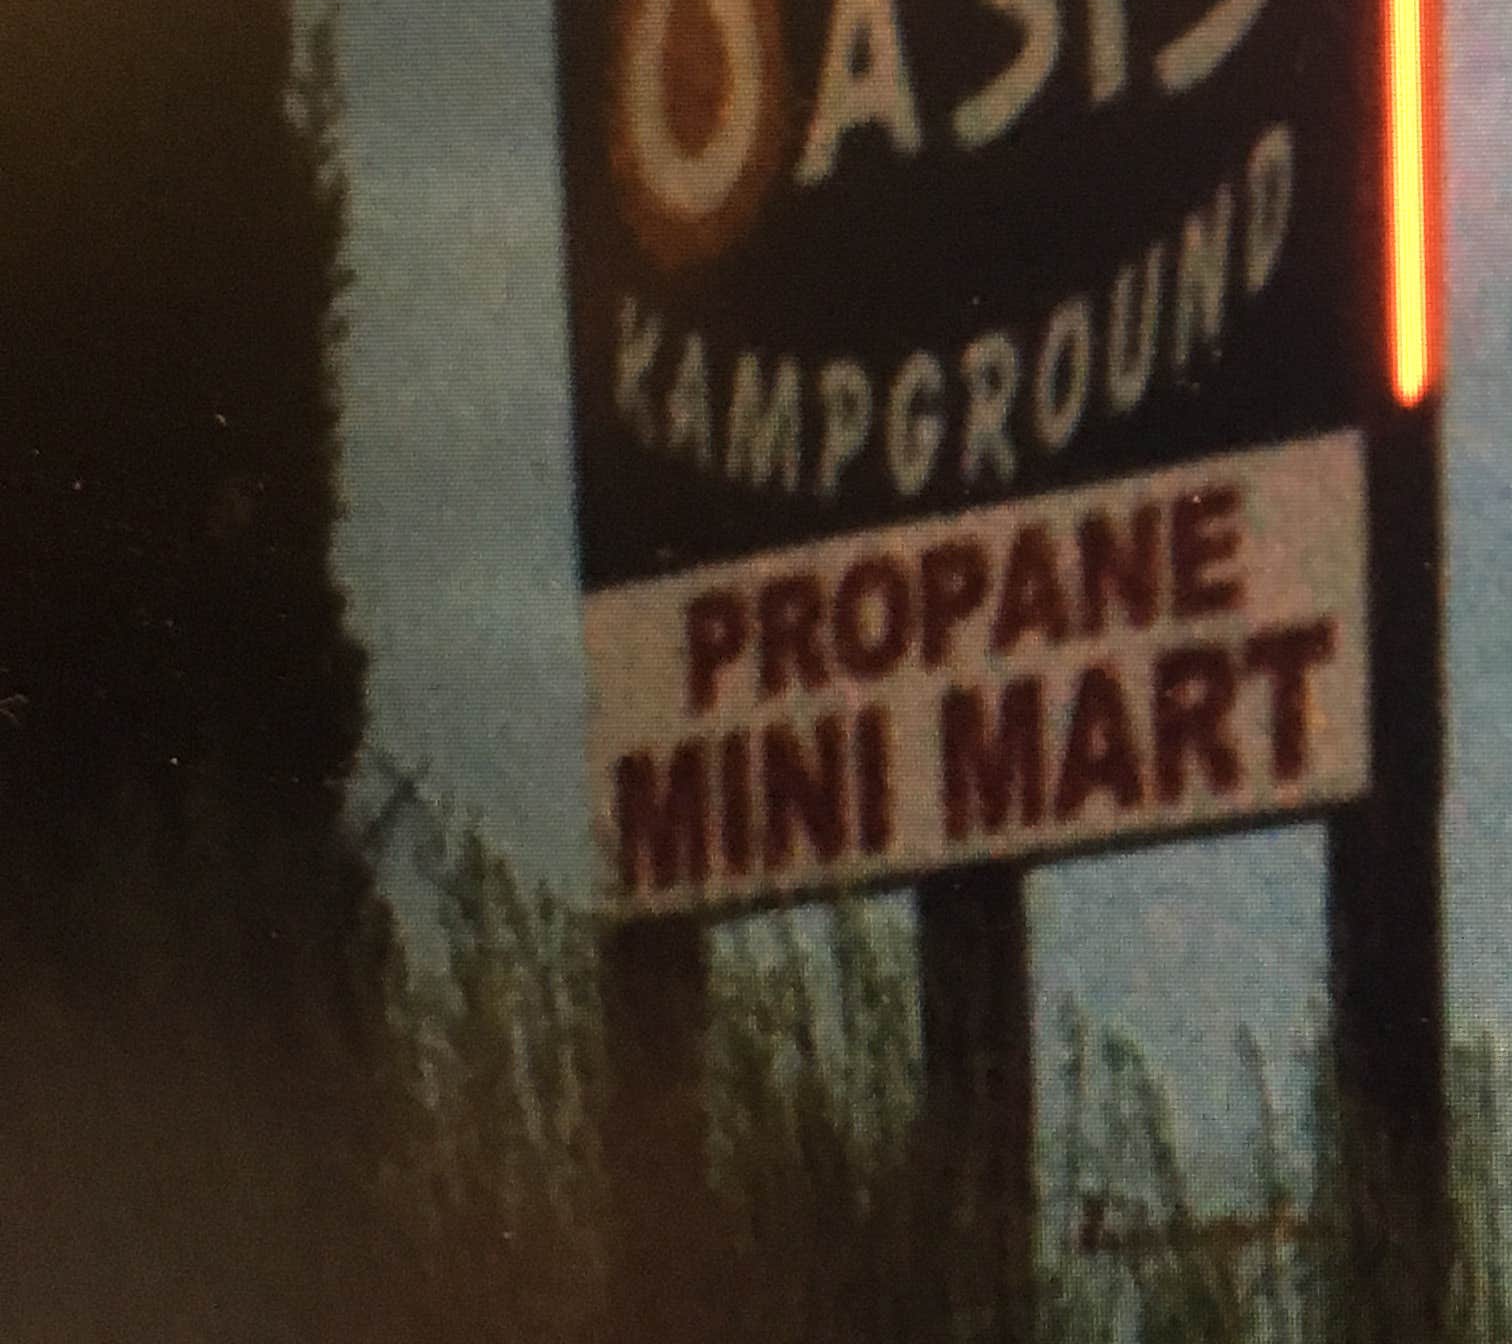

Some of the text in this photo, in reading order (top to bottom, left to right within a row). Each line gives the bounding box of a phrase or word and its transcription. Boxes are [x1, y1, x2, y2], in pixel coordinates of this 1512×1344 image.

[615, 122, 1294, 497] KAMPGROUND
[684, 484, 1245, 717] PROPANE
[614, 616, 1337, 896] MINI MART
